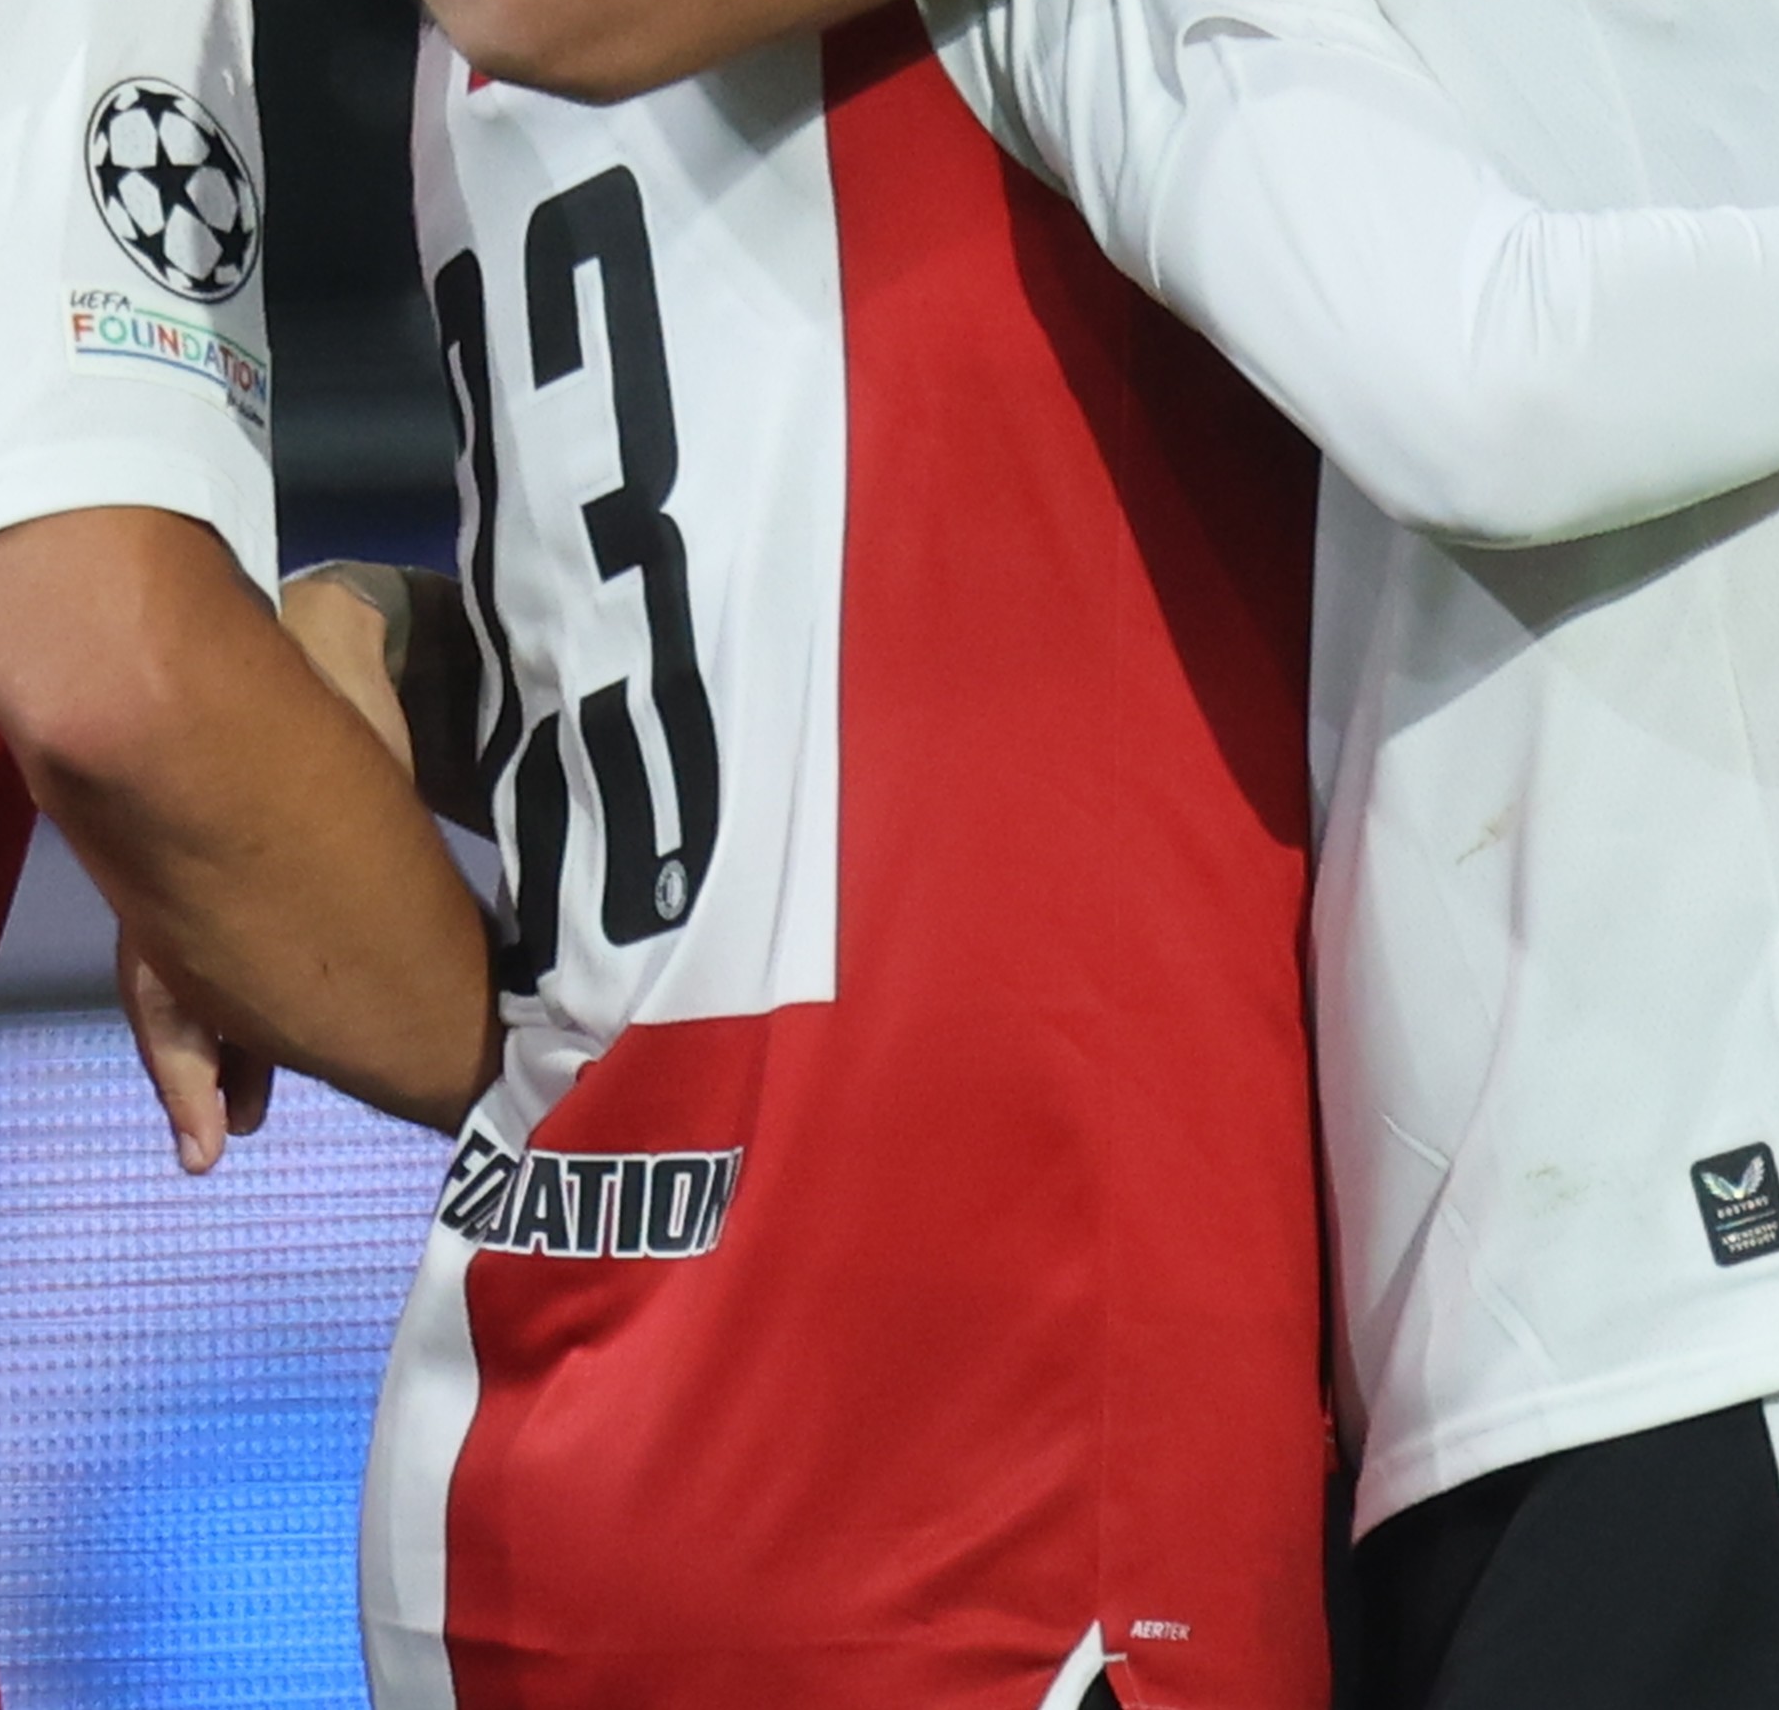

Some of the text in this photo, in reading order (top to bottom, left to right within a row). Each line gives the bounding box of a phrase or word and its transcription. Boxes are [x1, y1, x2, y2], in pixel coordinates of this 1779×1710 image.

[69, 289, 131, 312] UEFA
[71, 311, 268, 404] FOUNDATION
[438, 1126, 745, 1259] FOATION
